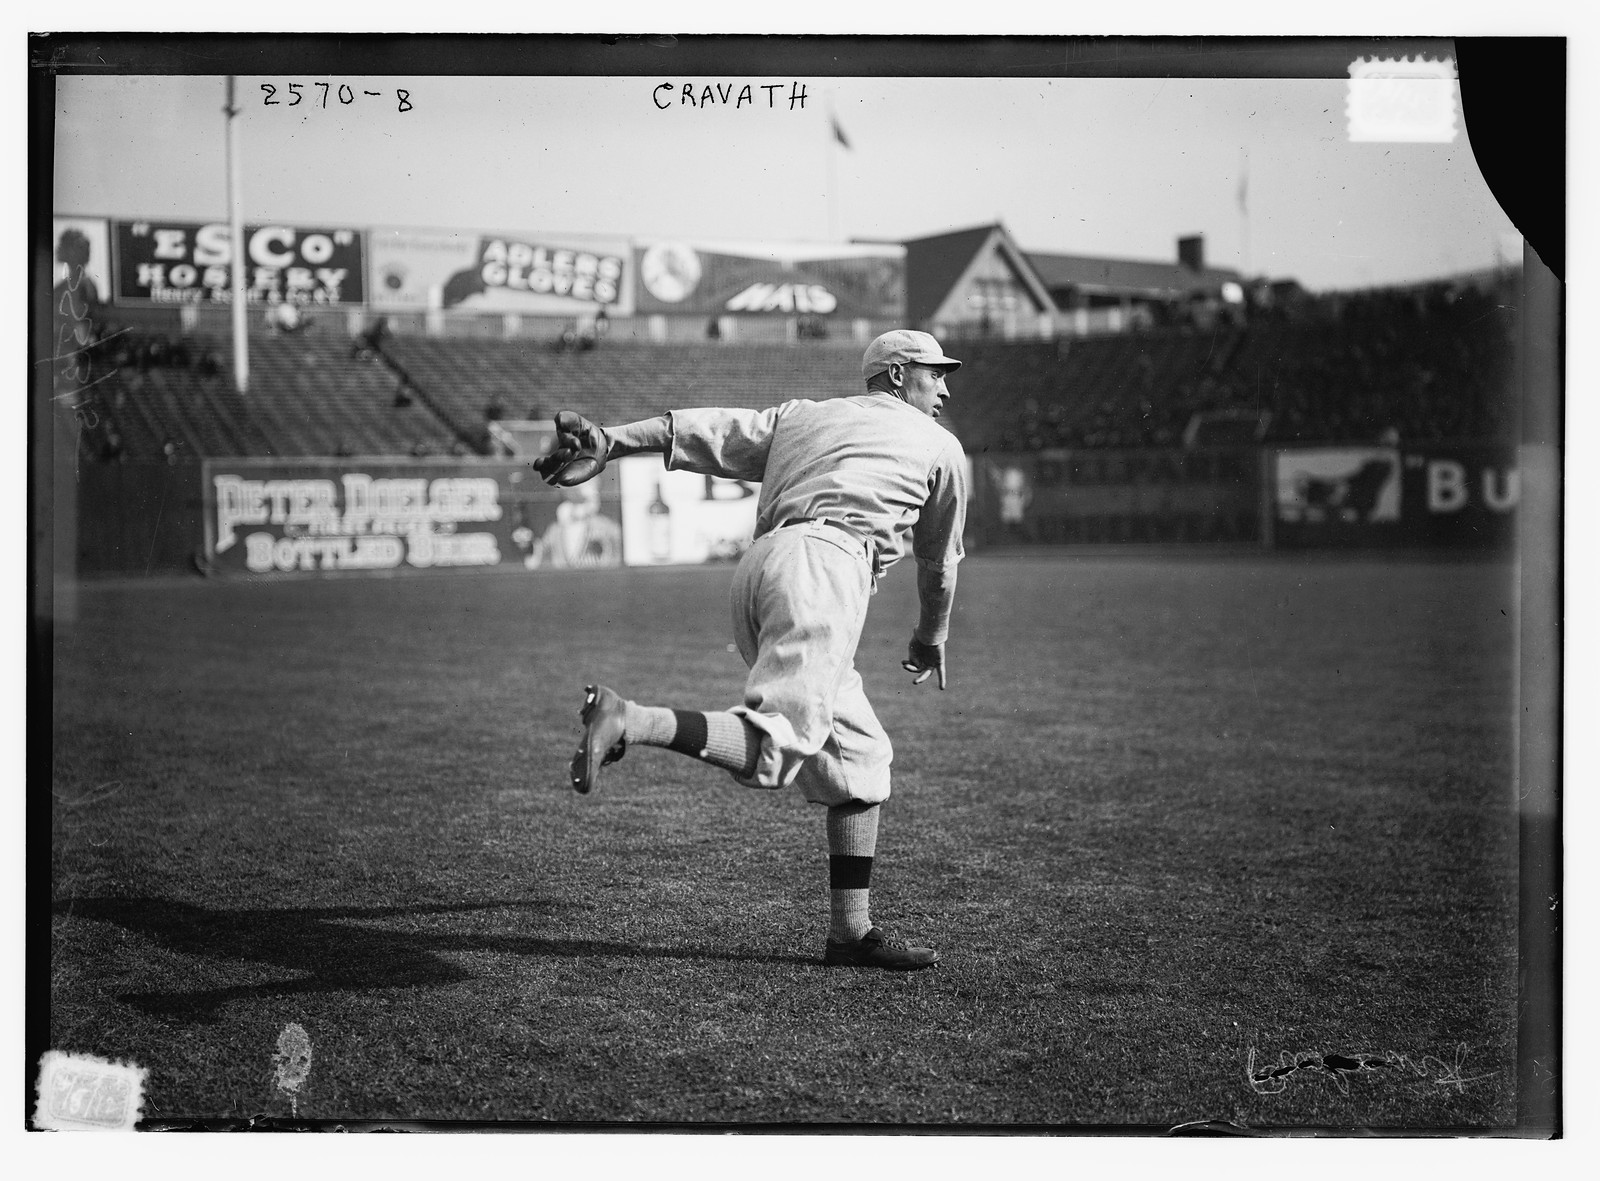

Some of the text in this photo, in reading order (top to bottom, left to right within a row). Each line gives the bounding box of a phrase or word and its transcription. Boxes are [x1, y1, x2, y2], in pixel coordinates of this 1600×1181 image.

[260, 82, 413, 113] 2570-8
[653, 81, 808, 110] CRAVATH
[137, 262, 348, 291] HOSERY
[481, 260, 617, 303] GLOVES
[213, 473, 502, 554] PETER DOELGER
[245, 528, 500, 572] BOTTLED BEER
